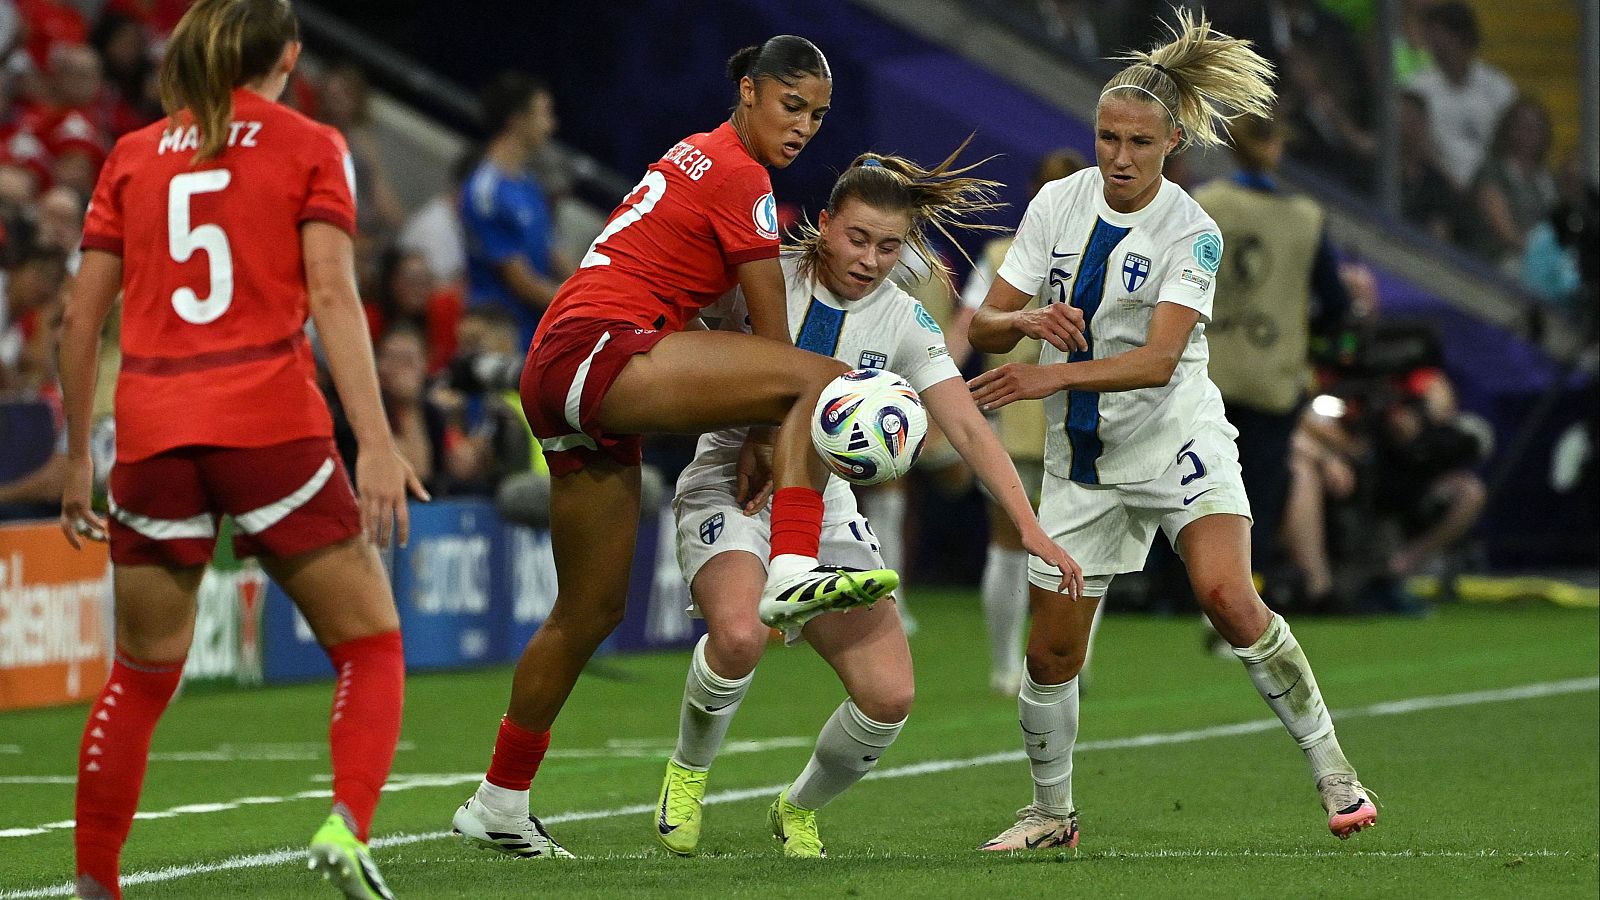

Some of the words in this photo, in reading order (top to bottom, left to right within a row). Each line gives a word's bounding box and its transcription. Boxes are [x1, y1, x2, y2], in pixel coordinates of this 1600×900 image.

[158, 121, 262, 155] MATZ
[168, 168, 234, 325] 5
[1049, 267, 1072, 304] 5
[1176, 438, 1207, 486] 5
